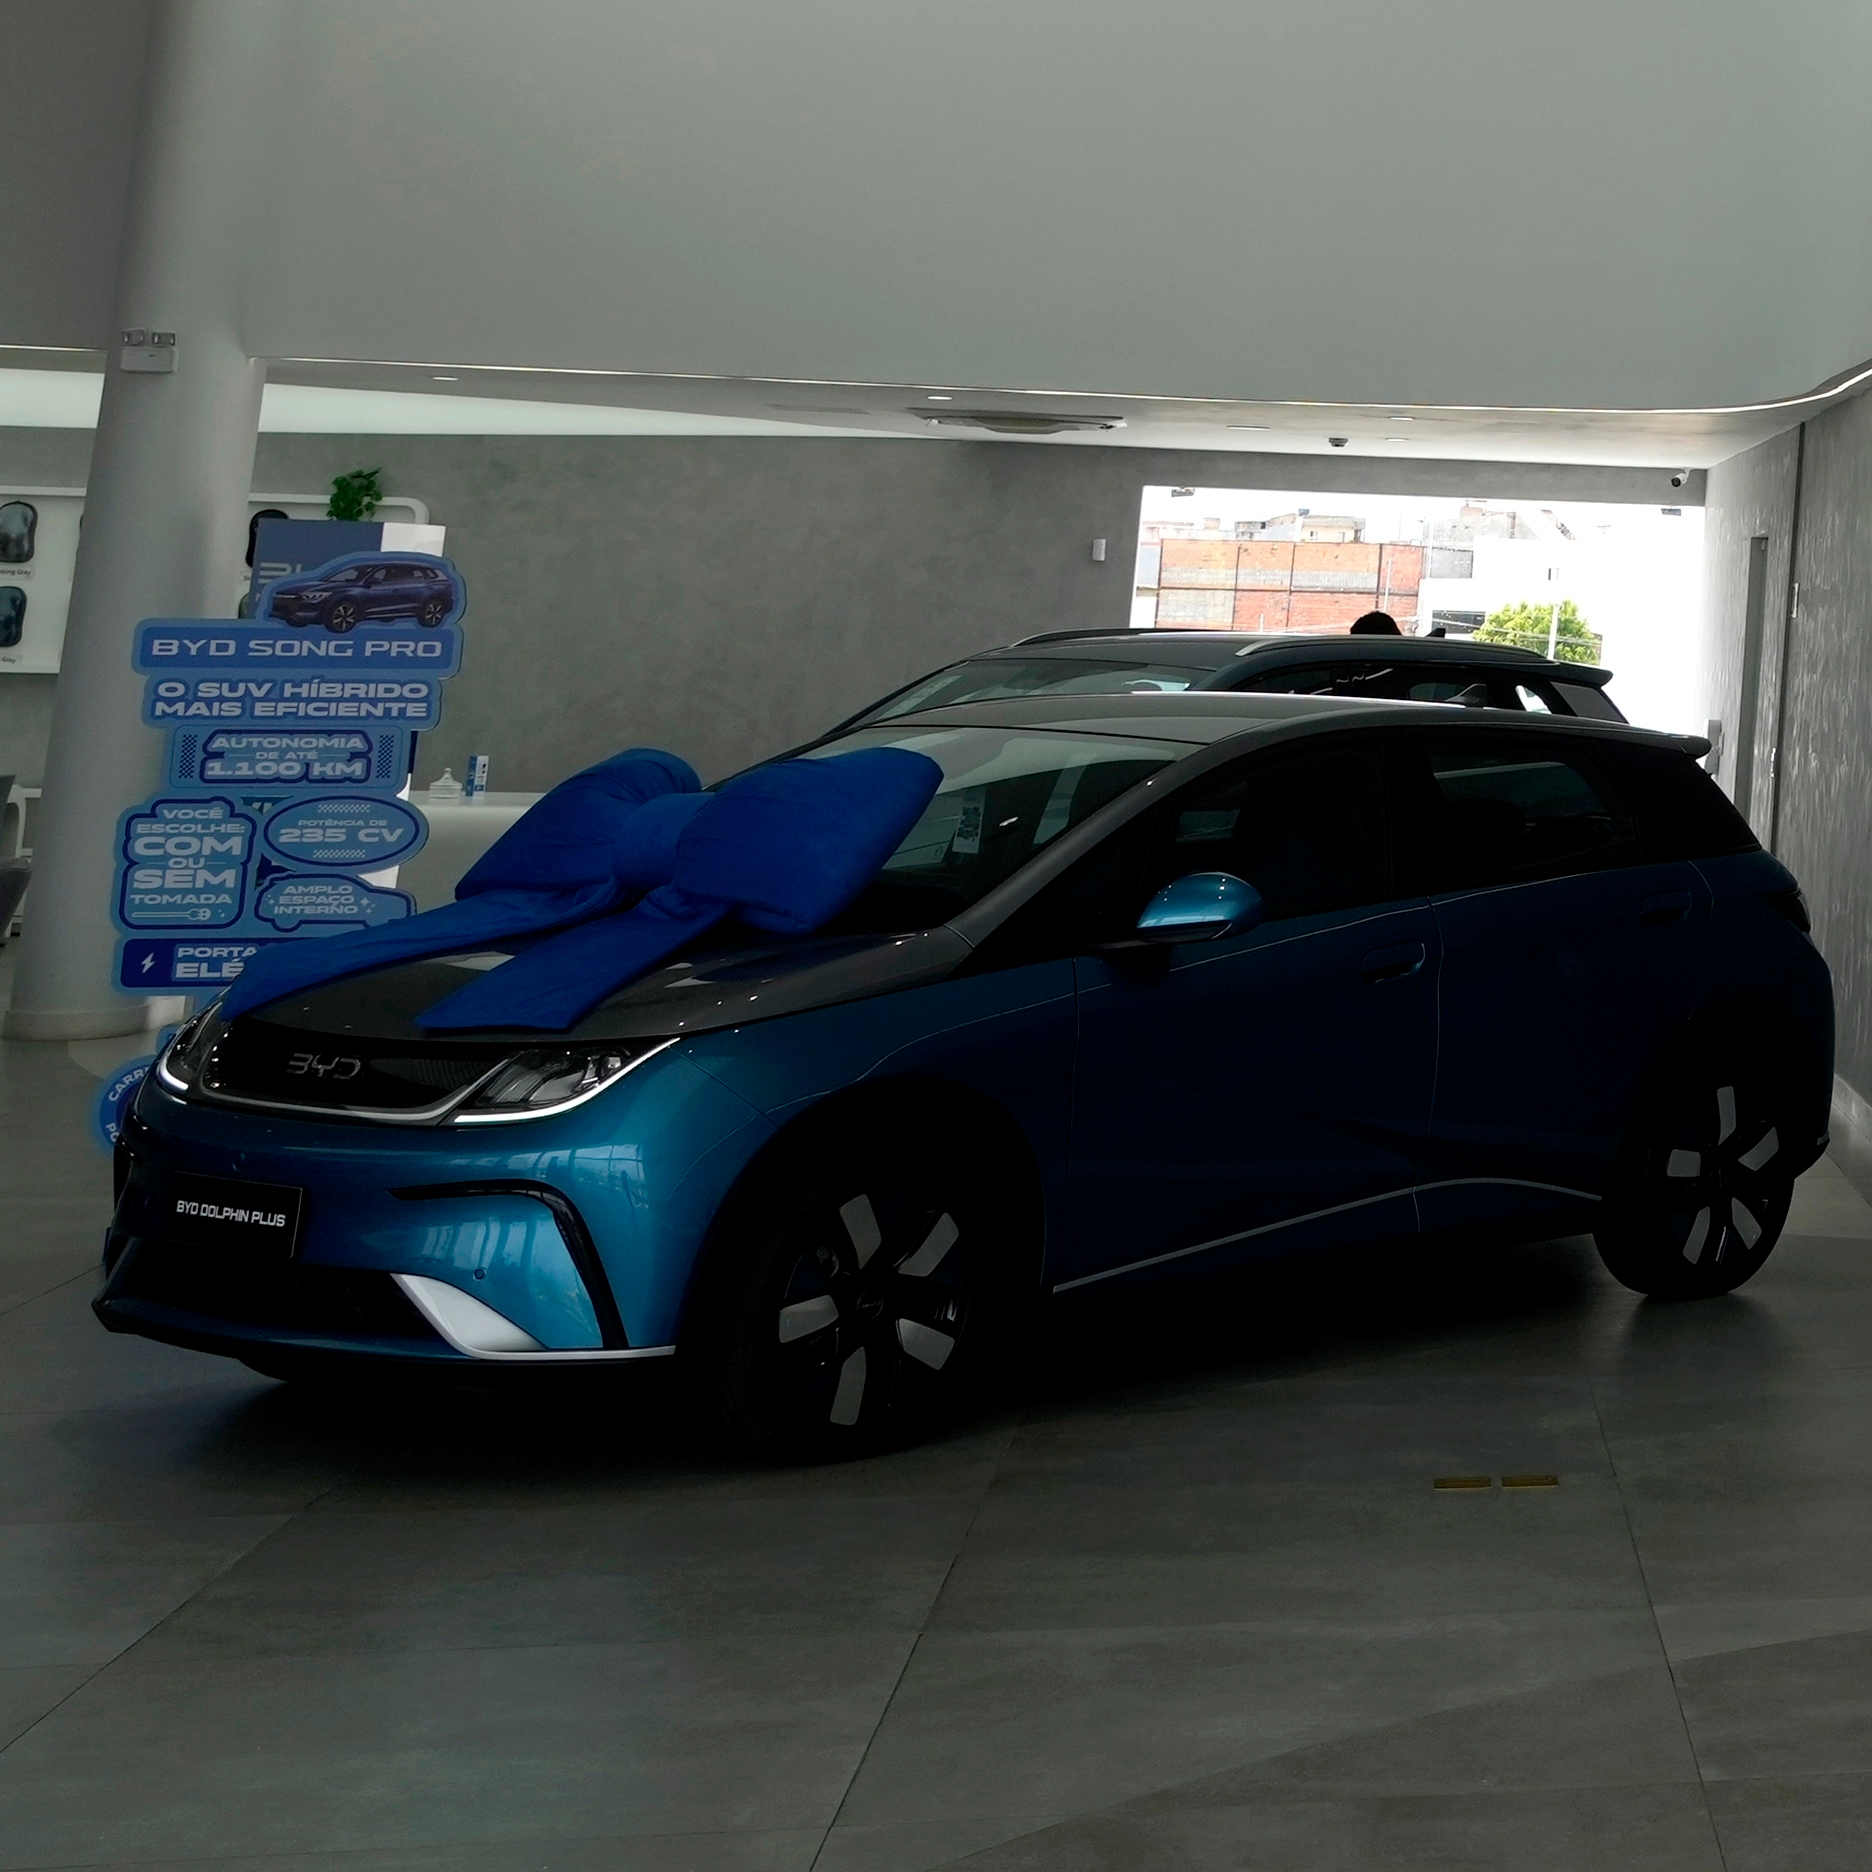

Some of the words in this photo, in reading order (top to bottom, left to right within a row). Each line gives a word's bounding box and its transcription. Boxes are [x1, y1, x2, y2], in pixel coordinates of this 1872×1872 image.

[151, 639, 236, 656] BYD
[248, 639, 354, 657] SONG
[364, 640, 443, 657] PRO
[157, 682, 186, 698] O
[197, 682, 274, 698] SUV
[283, 678, 429, 699] HÍBRIDO
[154, 701, 243, 716] MAIS
[254, 701, 428, 717] EFICIENTE
[211, 734, 365, 748] AUTONOMIA
[255, 751, 279, 759] DE
[284, 749, 319, 759] ATÉ
[206, 761, 302, 776] 1.100
[312, 762, 364, 777] KM
[162, 807, 224, 819] VOCÊ
[136, 824, 246, 834] ESCOLHE:
[297, 818, 365, 827] POTÊNCIA
[369, 819, 388, 827] DE
[278, 828, 346, 843] 235
[358, 828, 404, 843] CV
[133, 836, 242, 856] COM
[168, 857, 205, 868] OU
[132, 869, 236, 889] SEM
[282, 885, 353, 895] AMPLO
[130, 894, 233, 905] TOMADA
[278, 895, 356, 907] ESPAÇO
[273, 904, 359, 915] INTERNO
[286, 1051, 362, 1080] BYD
[108, 1066, 150, 1102] CARR
[176, 1200, 199, 1215] BYD
[200, 1203, 250, 1223] DOLPHIN
[251, 1211, 286, 1227] PLUS
